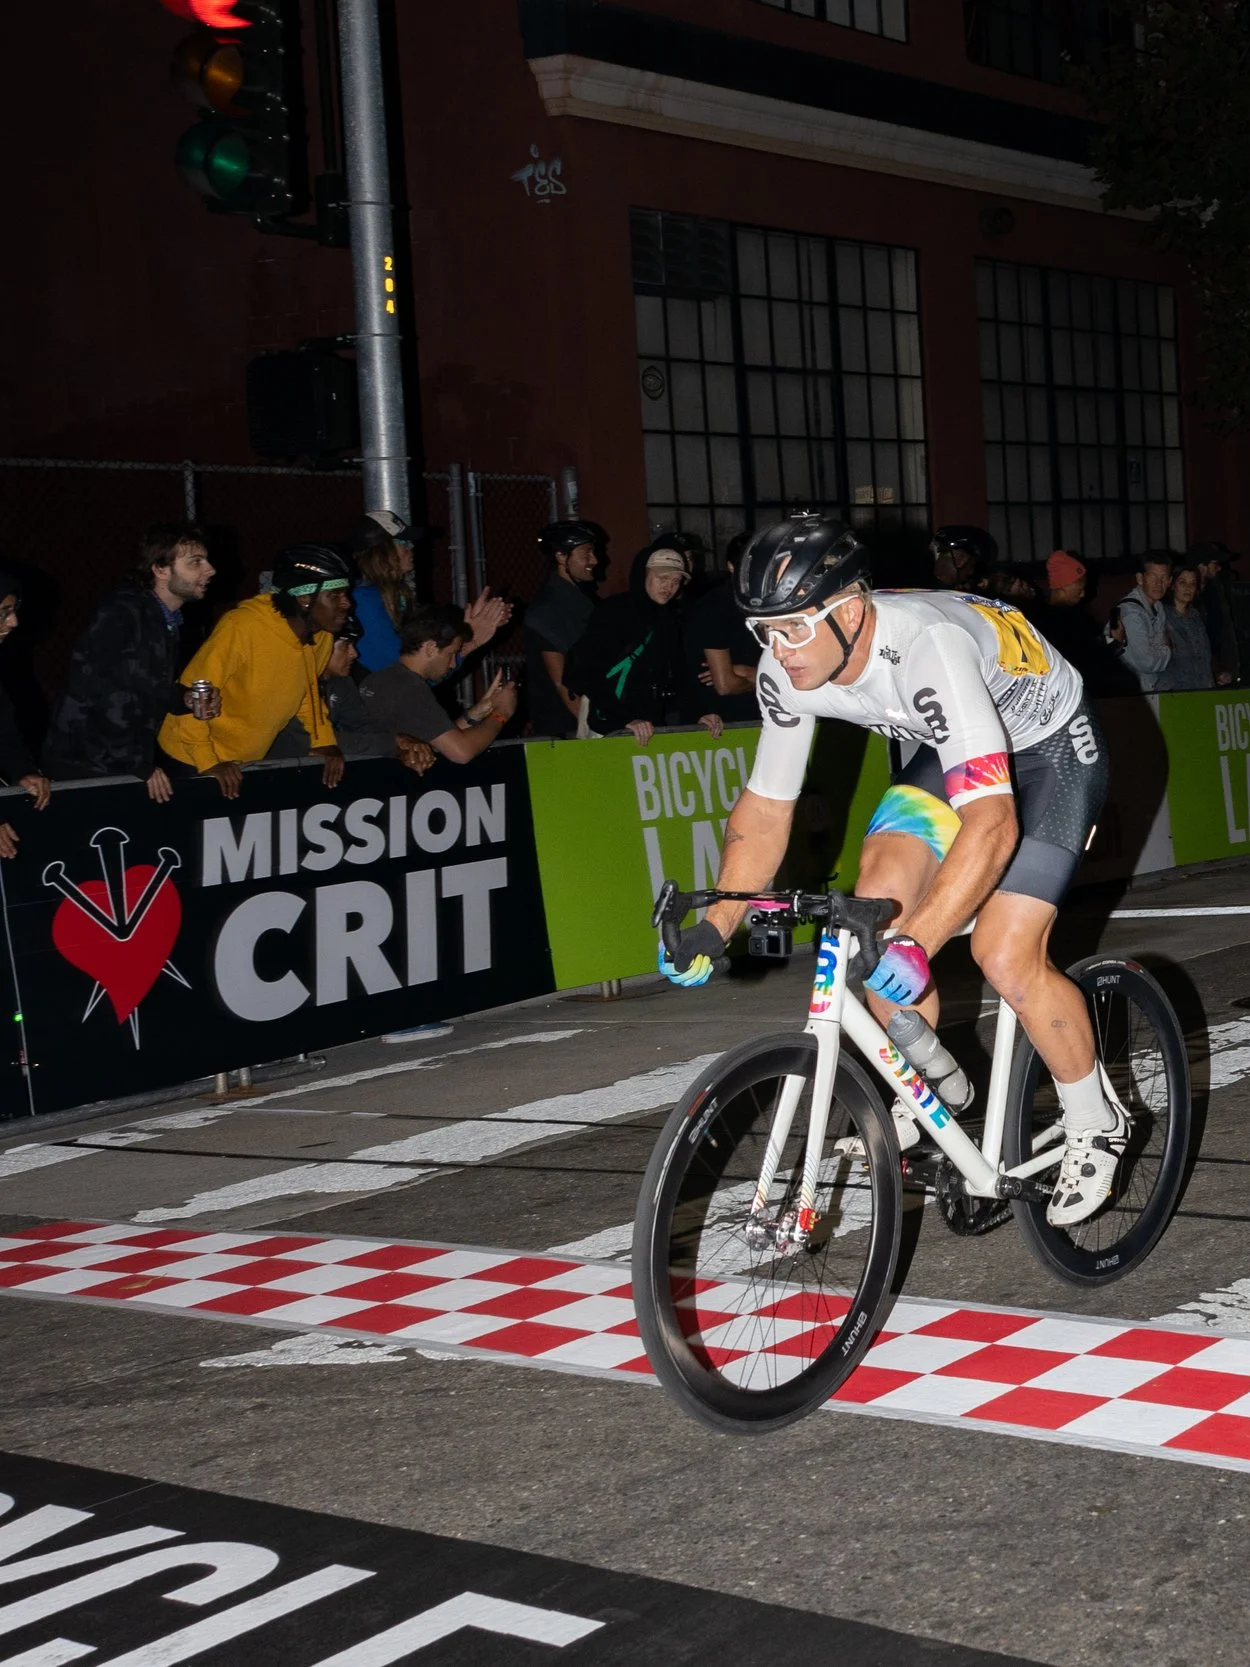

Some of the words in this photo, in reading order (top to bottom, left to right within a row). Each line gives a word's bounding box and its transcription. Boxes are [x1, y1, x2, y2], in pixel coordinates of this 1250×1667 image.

[631, 746, 751, 821] BICYCL
[202, 783, 506, 887] MISSION
[214, 857, 508, 1022] CRIT
[1104, 975, 1121, 985] HUNT
[841, 1318, 864, 1357] HUNT
